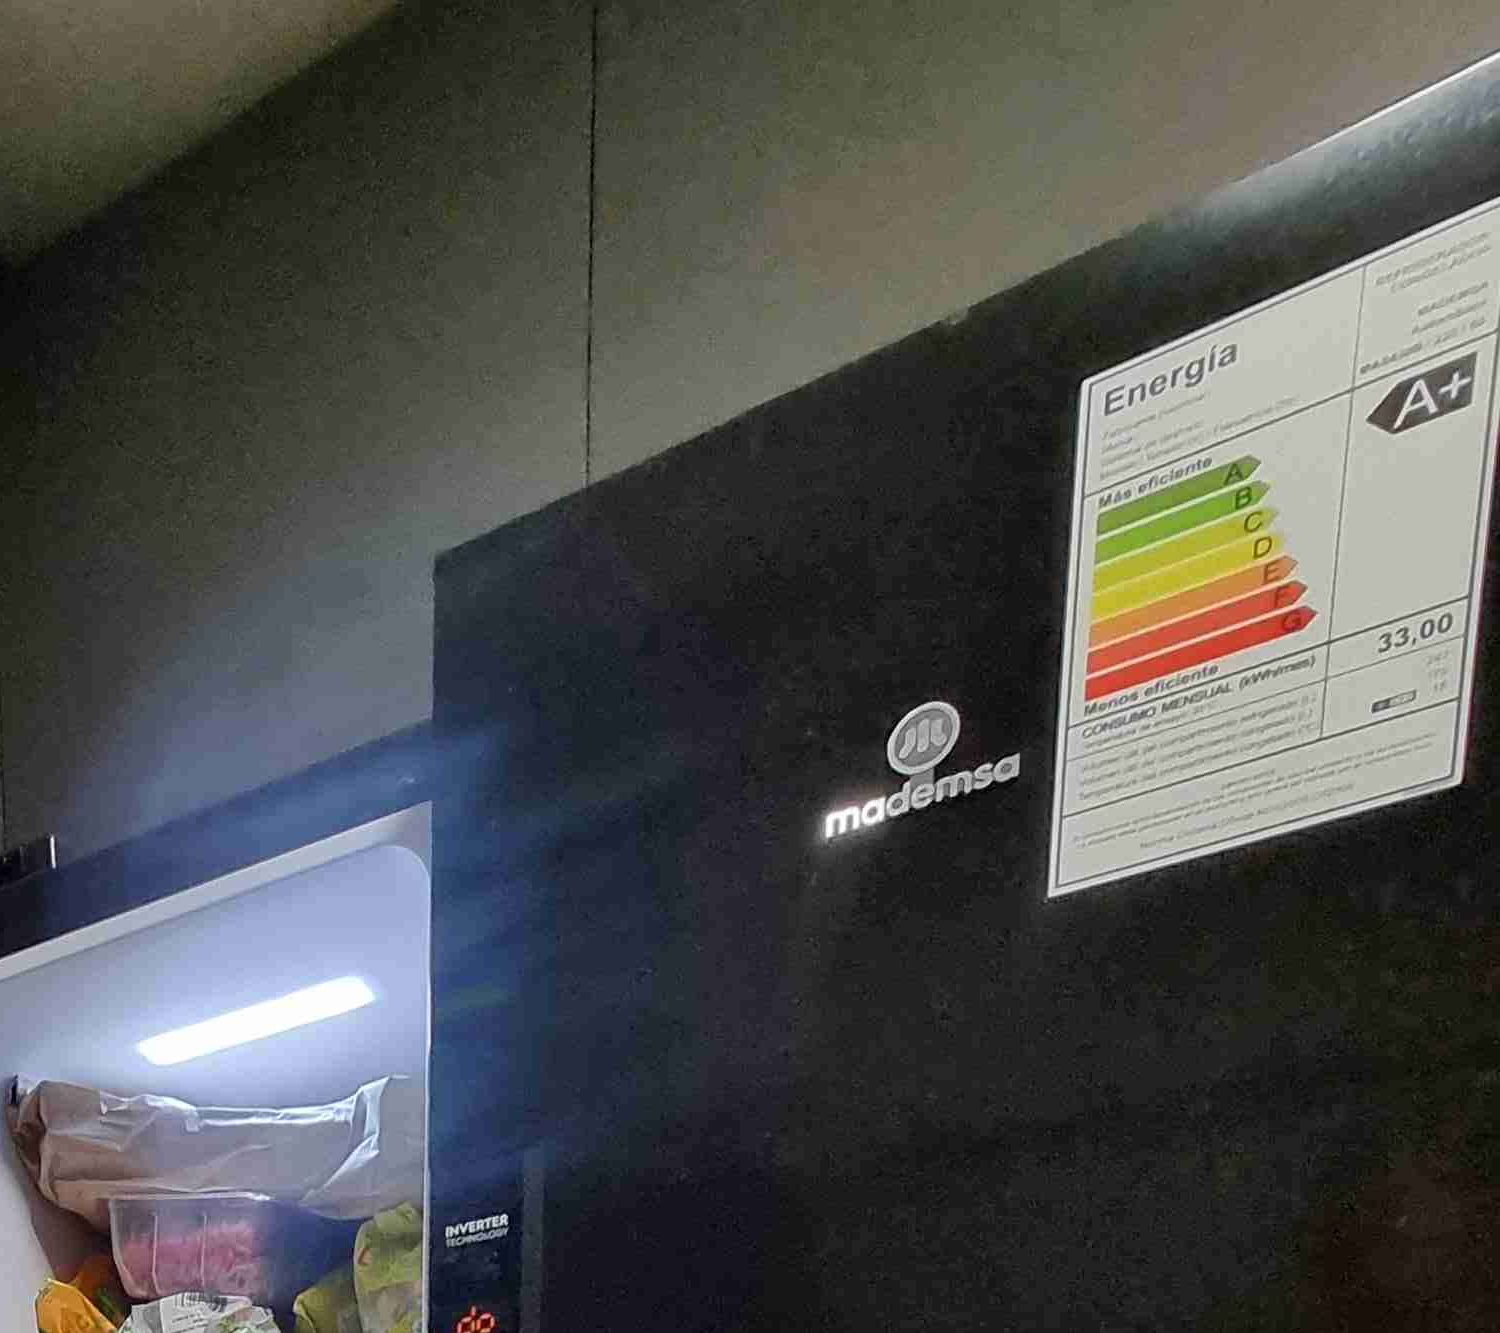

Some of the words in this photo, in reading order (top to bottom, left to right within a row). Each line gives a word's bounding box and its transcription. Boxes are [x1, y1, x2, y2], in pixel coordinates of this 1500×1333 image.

[1103, 343, 1238, 416] Energía
[1393, 371, 1472, 429] A+
[1099, 486, 1133, 507] Más
[1138, 457, 1213, 493] eficiente
[1224, 463, 1245, 486] A
[1235, 486, 1253, 510] B
[1244, 511, 1263, 533] C
[1253, 536, 1273, 559] D
[1263, 561, 1279, 585] E
[1275, 585, 1290, 608] F
[1282, 610, 1302, 632] G
[1377, 612, 1454, 653] 33,00
[1083, 690, 1139, 717] Menos
[1144, 663, 1219, 697] eficiente
[1082, 707, 1157, 739] CONSUMO
[1161, 683, 1232, 714] MENSUAL
[825, 752, 1021, 839] mademsa
[445, 1213, 509, 1238] INVERTER
